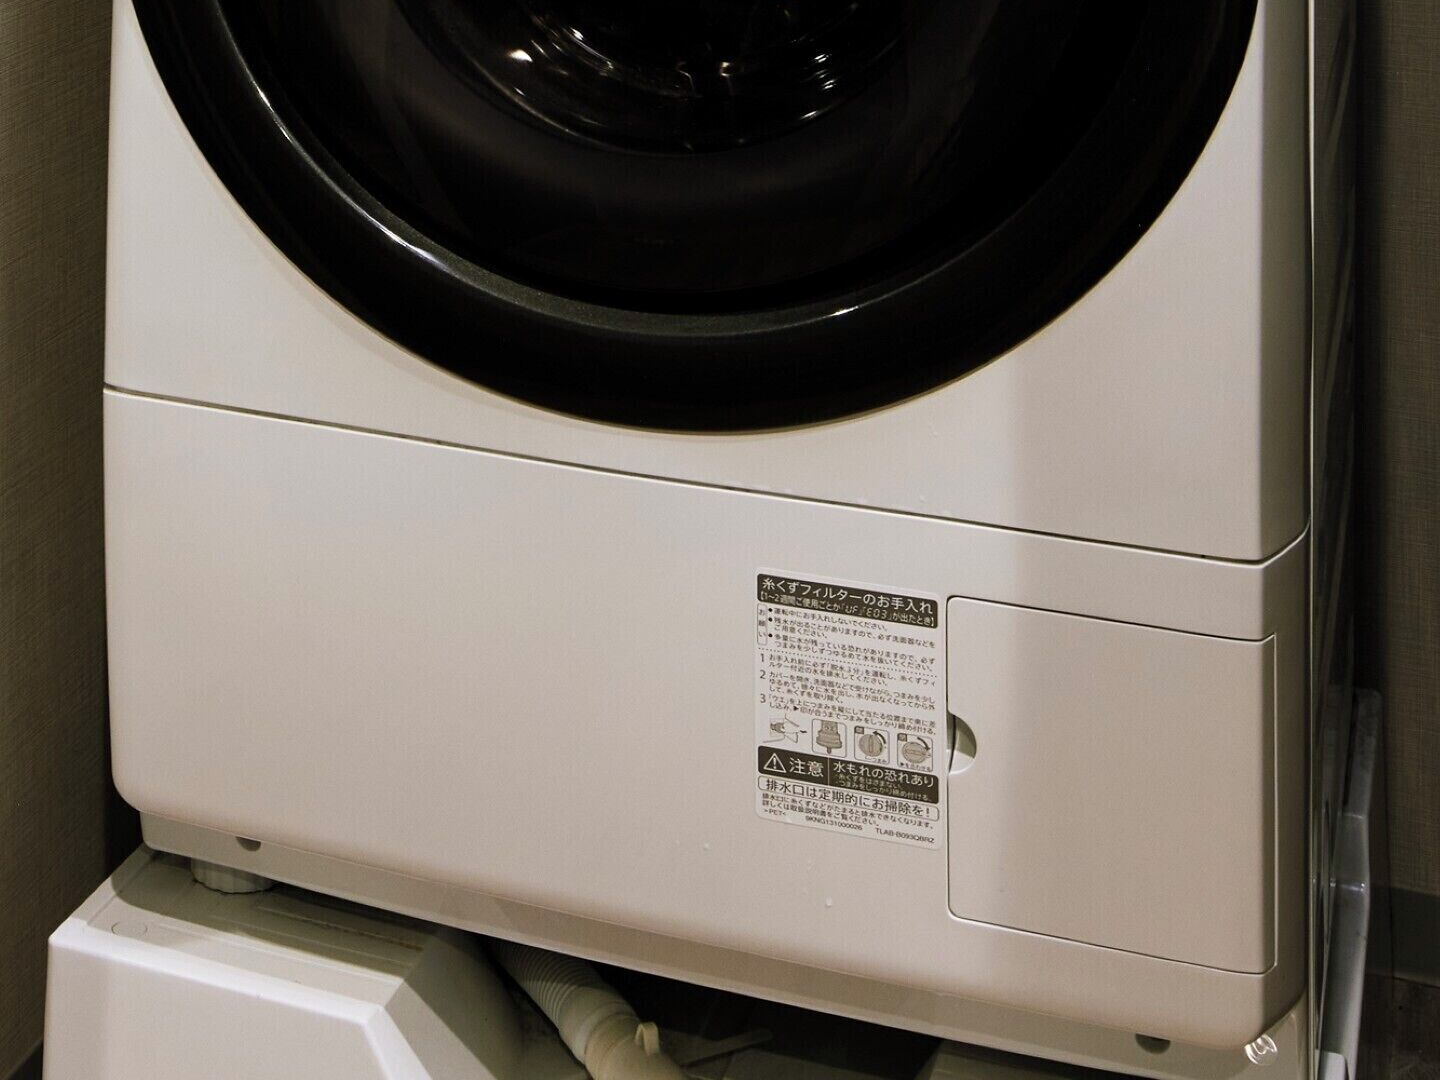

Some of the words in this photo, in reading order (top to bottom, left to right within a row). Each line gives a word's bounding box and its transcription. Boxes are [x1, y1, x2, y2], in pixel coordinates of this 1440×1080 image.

[762, 577, 933, 615] 糸くずフィルターのお手入れ
[760, 653, 765, 662] 1
[760, 669, 766, 680] 2
[760, 694, 766, 704] 3
[789, 757, 824, 778] 注意
[833, 760, 934, 788] 水もれの恐れあり
